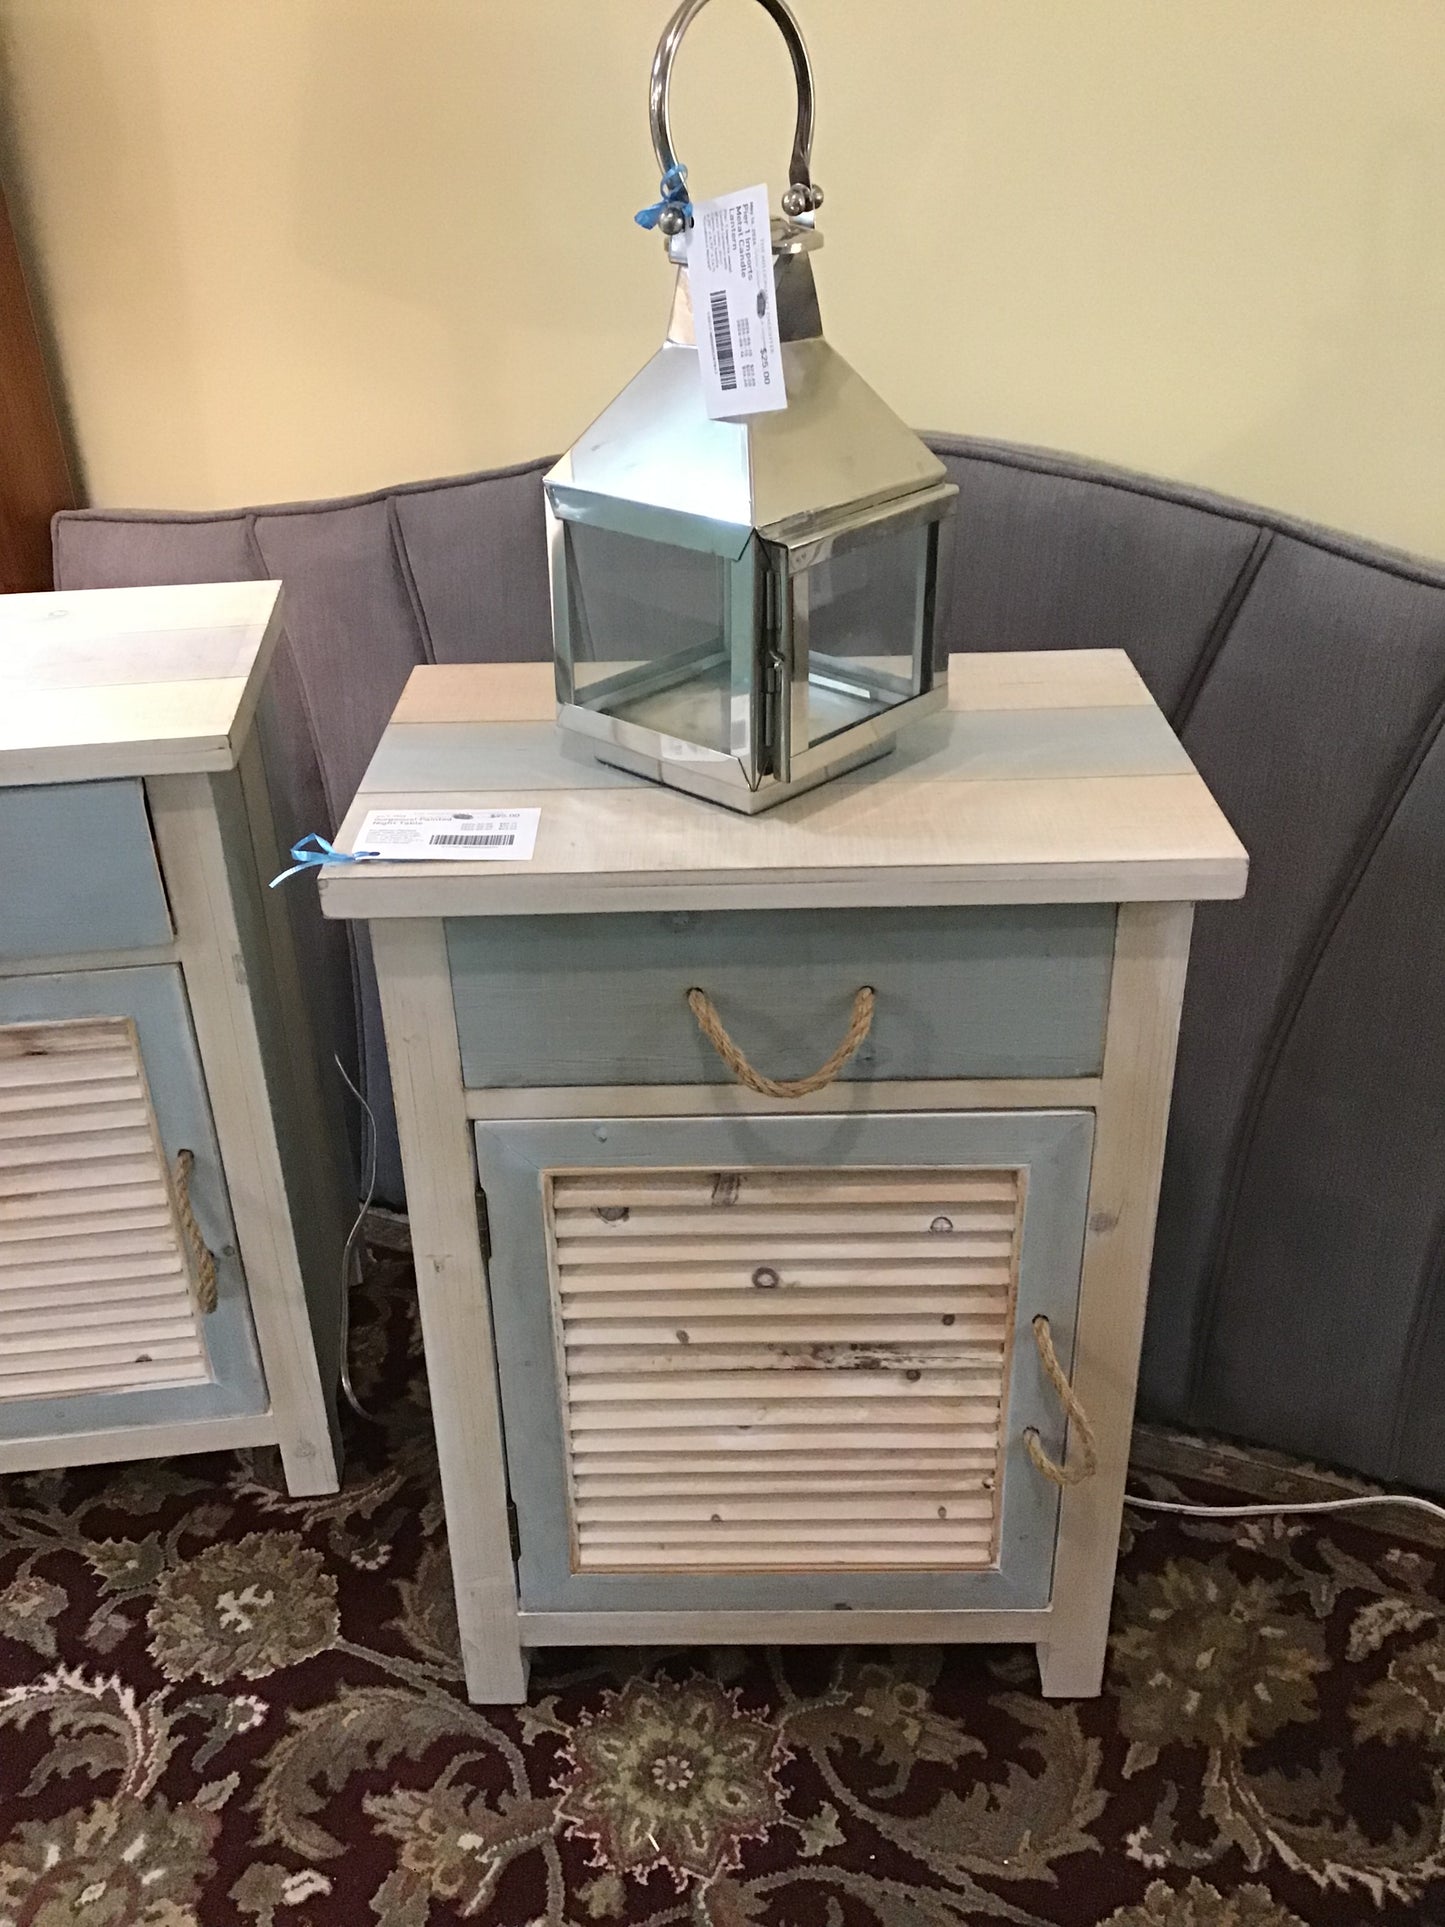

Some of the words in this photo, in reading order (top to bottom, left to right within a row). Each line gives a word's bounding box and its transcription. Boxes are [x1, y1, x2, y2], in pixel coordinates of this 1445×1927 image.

[728, 207, 737, 251] Lantern
[735, 205, 743, 236] Metal
[738, 238, 747, 278] Candle
[744, 237, 754, 281] Imports
[760, 346, 770, 385] $25.00
